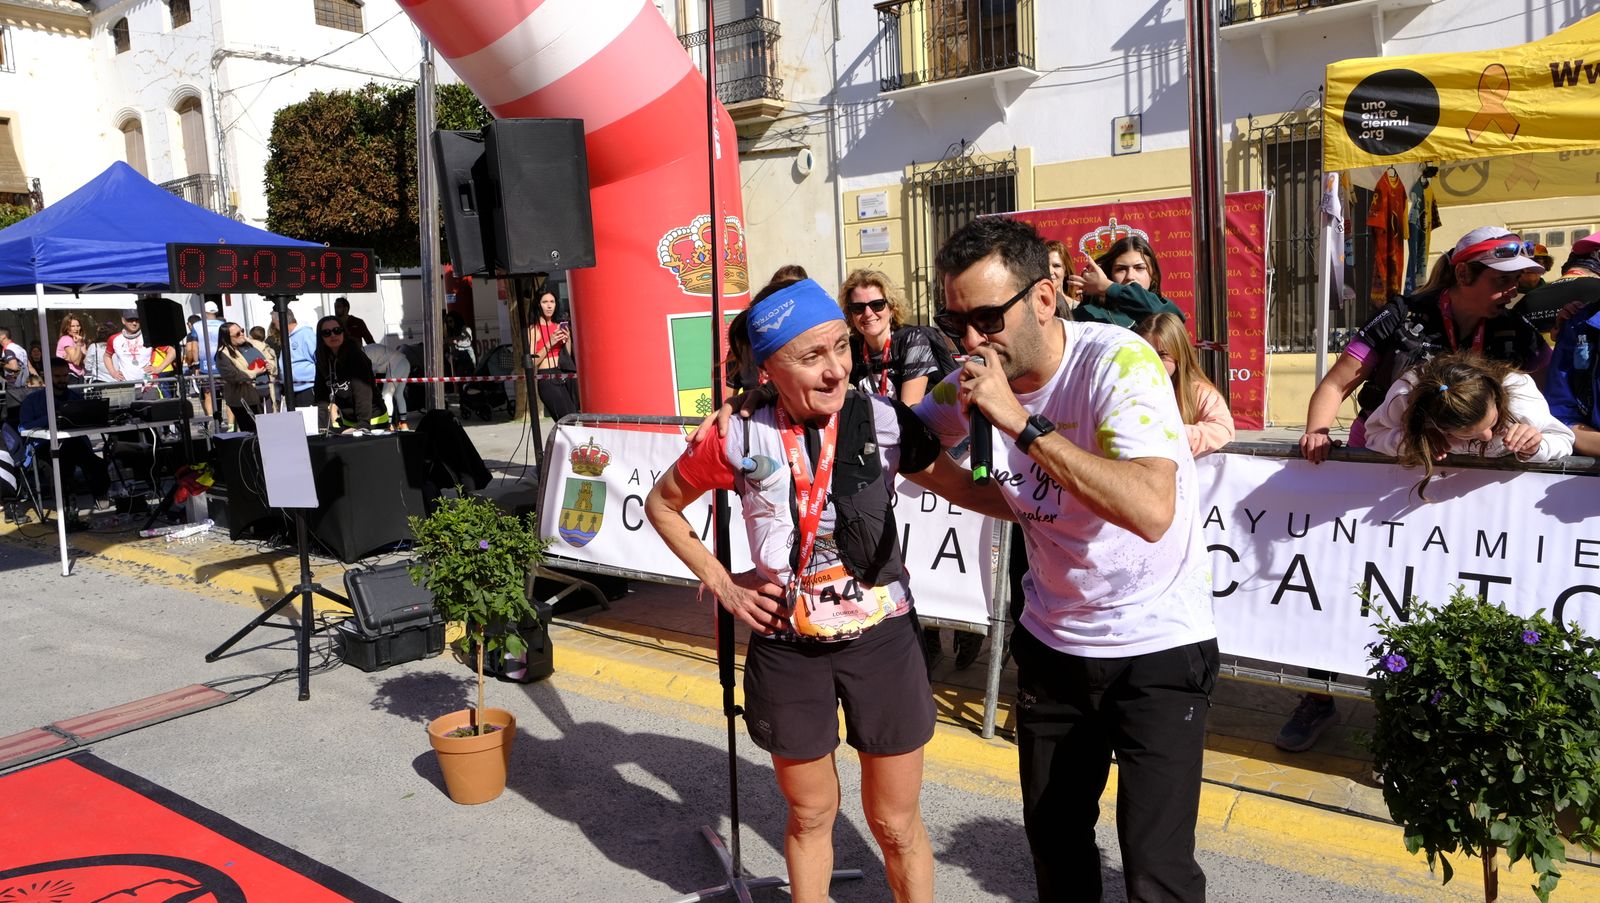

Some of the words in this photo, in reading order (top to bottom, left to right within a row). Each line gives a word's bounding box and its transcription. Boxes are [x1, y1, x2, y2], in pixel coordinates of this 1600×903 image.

[1361, 101, 1386, 110] uno
[1361, 110, 1398, 119] entre
[1358, 129, 1385, 141] .org
[1061, 216, 1102, 226] CANTORIA
[1122, 212, 1146, 221] AYTO.
[1167, 231, 1192, 239] AYTO.
[179, 248, 369, 288] 03:03:03
[1167, 272, 1192, 280] AYTO.
[820, 579, 864, 606] 44
[832, 609, 859, 617] LOURDES
